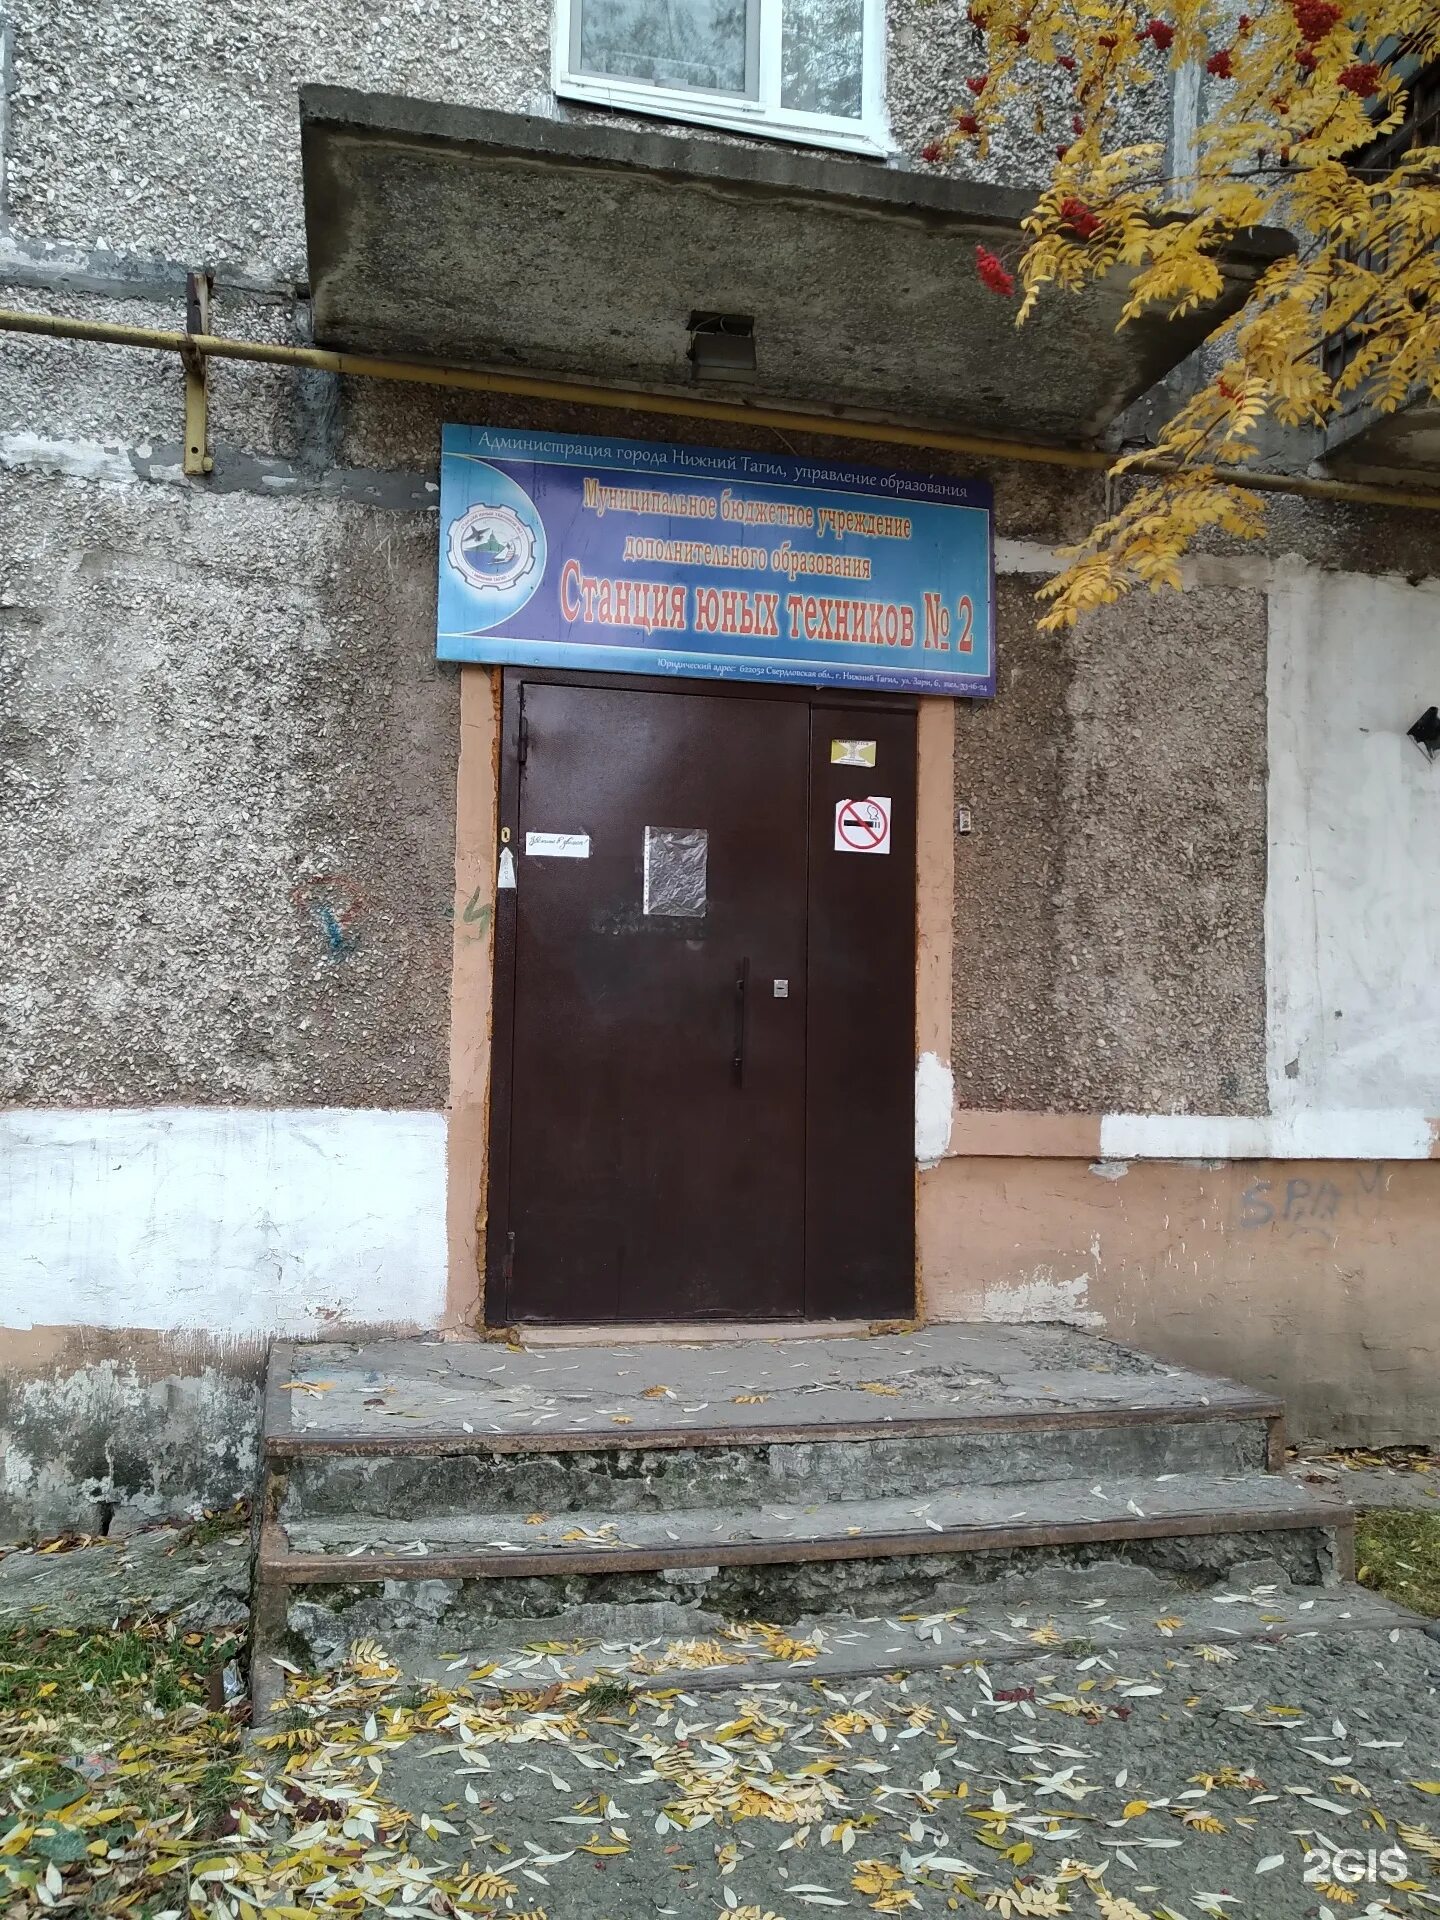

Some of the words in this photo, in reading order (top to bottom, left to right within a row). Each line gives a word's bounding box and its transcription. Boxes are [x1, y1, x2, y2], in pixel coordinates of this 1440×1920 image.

[478, 432, 612, 459] Администрация
[616, 447, 667, 466] города
[673, 449, 737, 471] Нижний
[740, 456, 787, 476] Тагил,
[794, 464, 877, 486] управление
[880, 474, 968, 498] образования
[583, 477, 717, 519] Муниципальное
[721, 488, 814, 529] бюджетное
[817, 506, 913, 540] учреждение
[623, 535, 767, 570] дополнительного
[772, 540, 872, 581] образования
[560, 558, 686, 636] Станция
[695, 586, 780, 637] юных
[787, 593, 915, 648] техников
[957, 594, 974, 653] 2
[657, 658, 712, 673] Юридический
[713, 664, 736, 677] адрес:
[739, 664, 765, 676] 622052
[766, 666, 817, 678] Свердловская
[843, 671, 875, 683] Нижний
